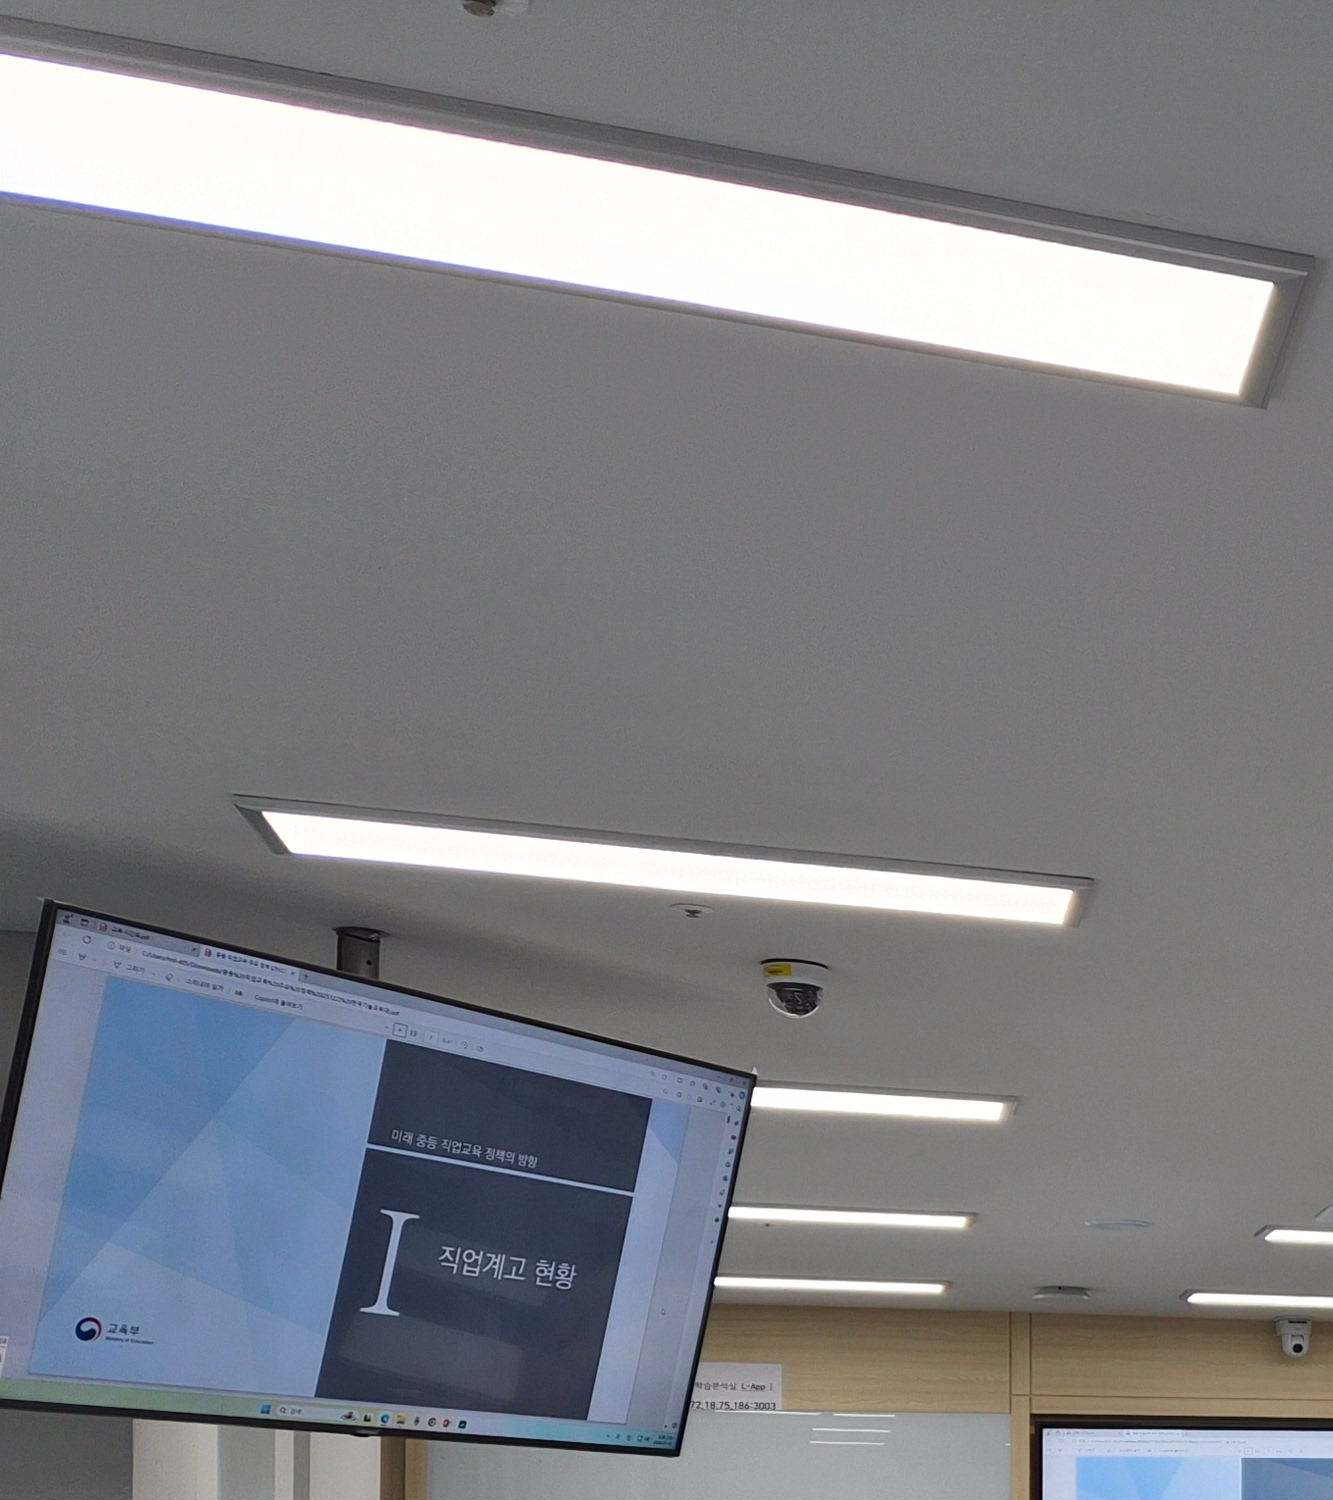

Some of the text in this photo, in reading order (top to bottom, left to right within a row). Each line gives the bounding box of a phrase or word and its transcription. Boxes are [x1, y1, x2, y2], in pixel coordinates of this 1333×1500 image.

[391, 1129, 539, 1169] 미래 중등 직업교육 정책의 방향
[437, 1245, 578, 1291] 직업계고 현황
[106, 1322, 141, 1337] 교육부
[740, 1383, 766, 1392] L-App
